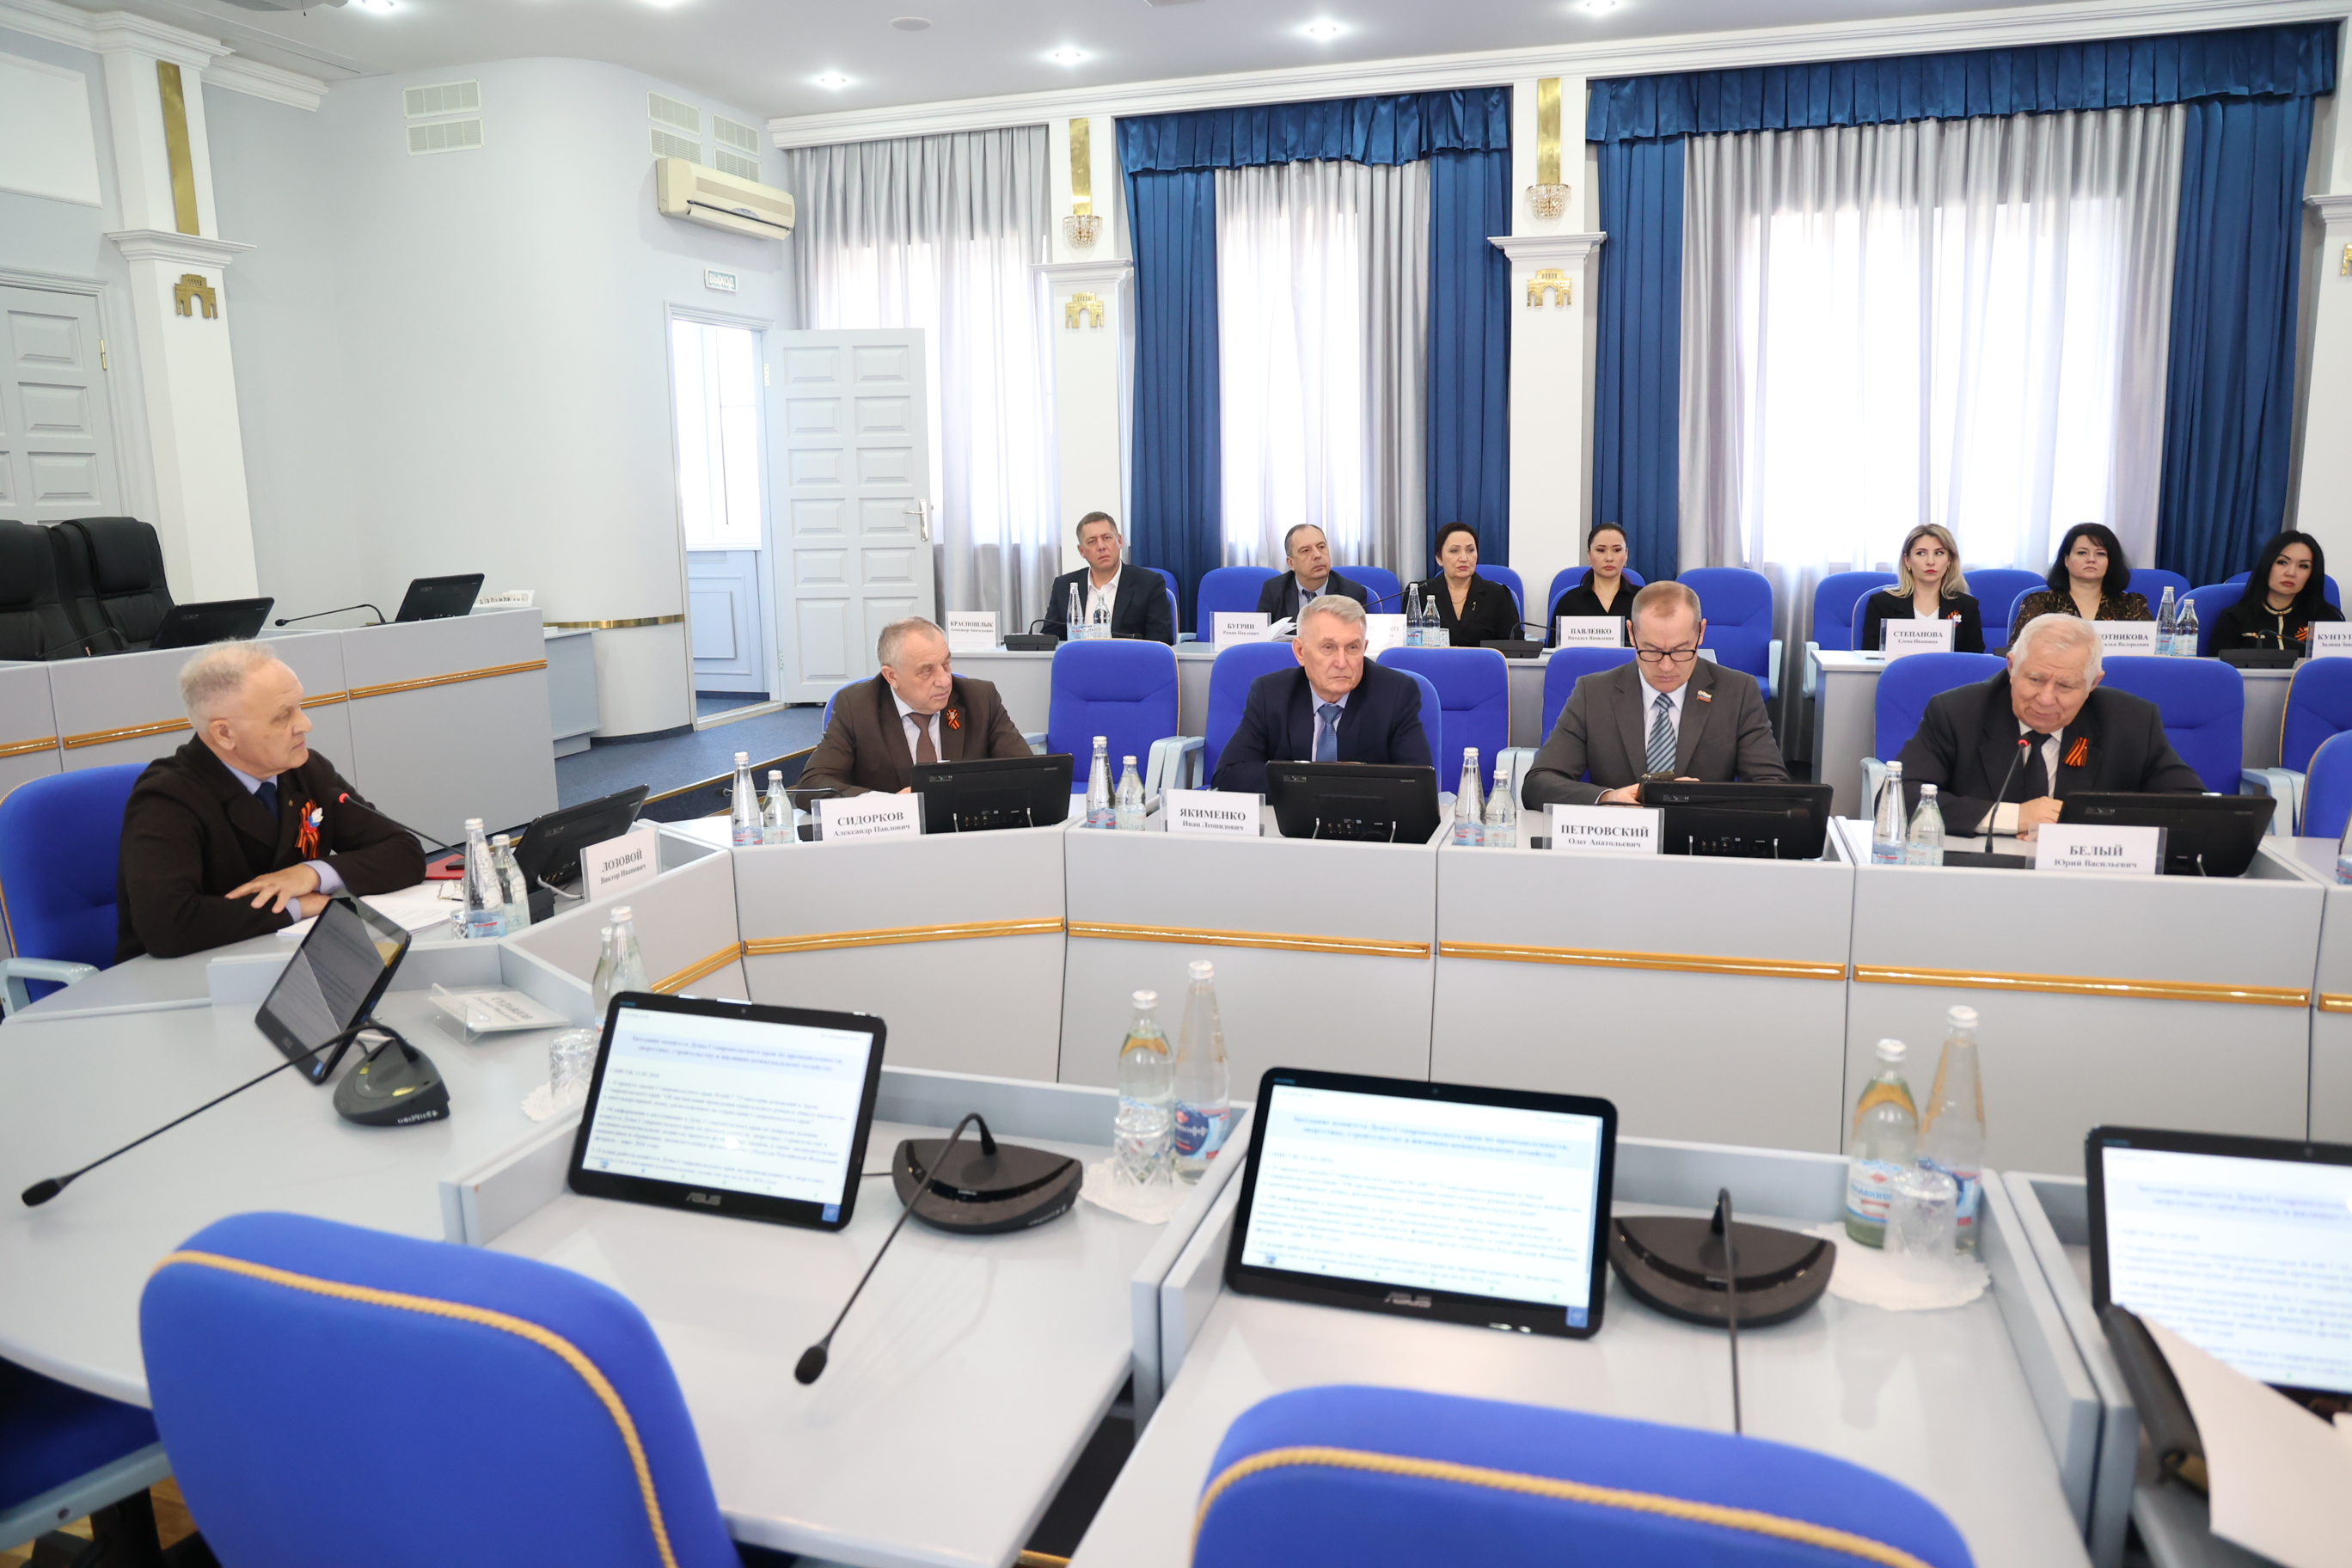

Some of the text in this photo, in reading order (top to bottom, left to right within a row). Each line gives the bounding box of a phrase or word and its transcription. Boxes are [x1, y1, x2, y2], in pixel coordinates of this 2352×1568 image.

[709, 273, 735, 288] ВЫХОД
[837, 812, 903, 826] СИДОРКОВ
[1179, 808, 1246, 822] ЯКИМЕНКО
[833, 824, 910, 837] Александр Павлович
[1202, 822, 1244, 831] Леонидович
[1560, 824, 1649, 838] ПЕТРОВСКИЙ
[1589, 839, 1641, 848] Анатольевич
[2069, 843, 2123, 856] БЕЛЫЙ
[602, 848, 642, 873] ЛОЗОВОЙ
[2054, 858, 2137, 869] Юрий Васильевич
[600, 864, 646, 885] Виктор Иванович
[685, 1191, 722, 1206] ASUS
